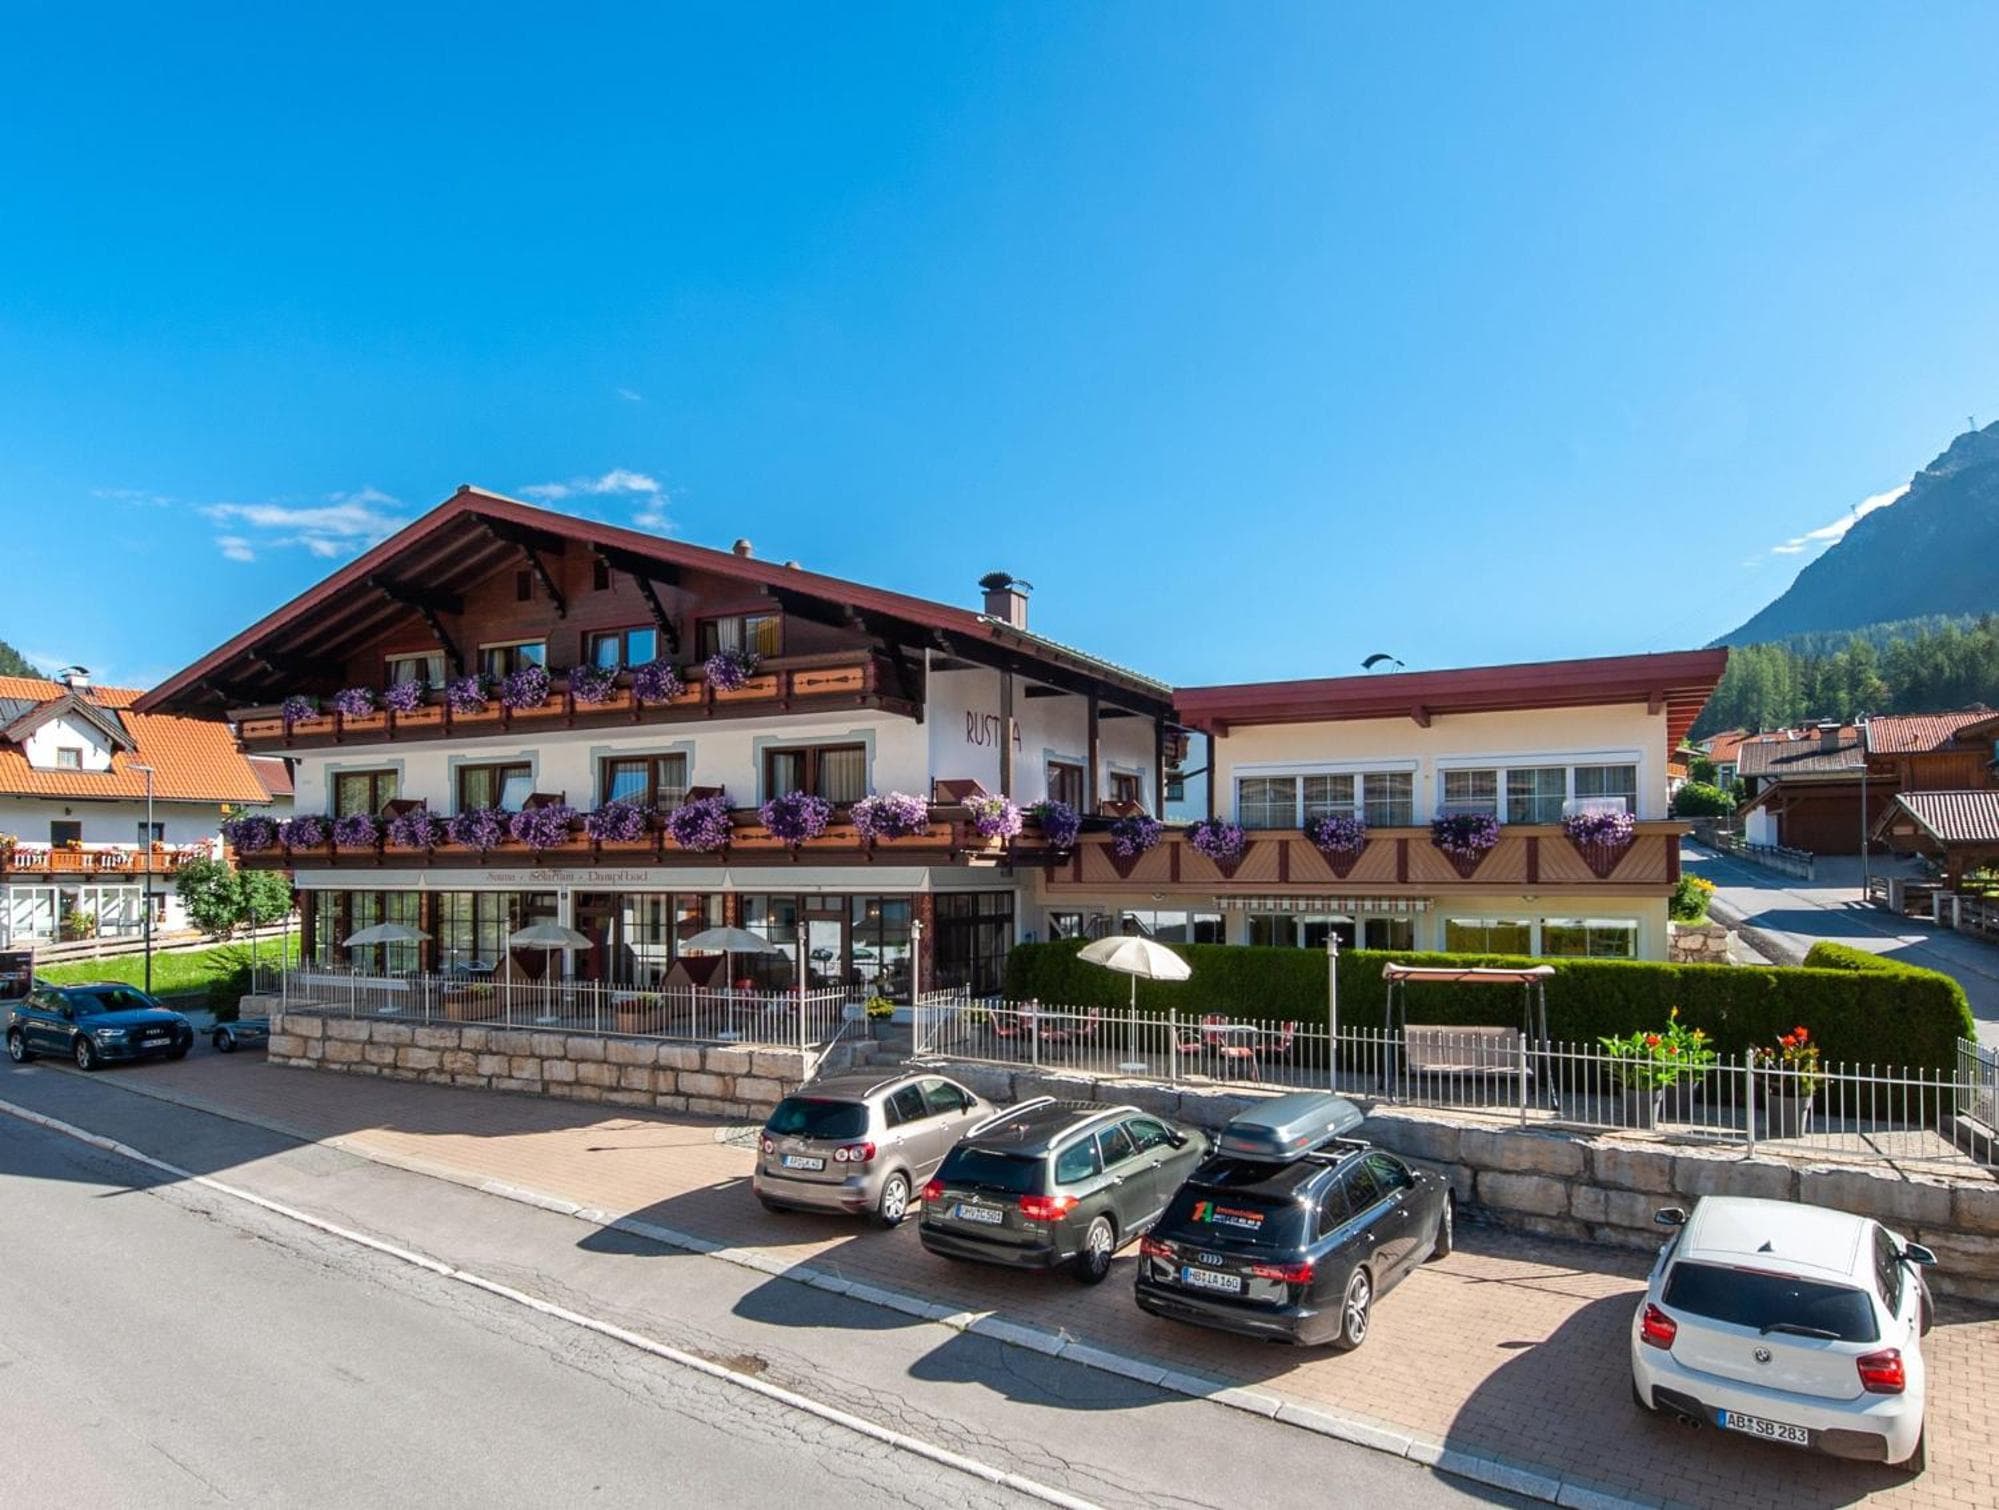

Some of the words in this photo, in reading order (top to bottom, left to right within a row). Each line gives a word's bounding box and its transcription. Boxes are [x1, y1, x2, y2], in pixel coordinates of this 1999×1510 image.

[966, 710, 1022, 753] RUSTA
[1727, 1413, 1746, 1429] AB
[1755, 1420, 1775, 1436] SB
[1778, 1425, 1807, 1442] 283
